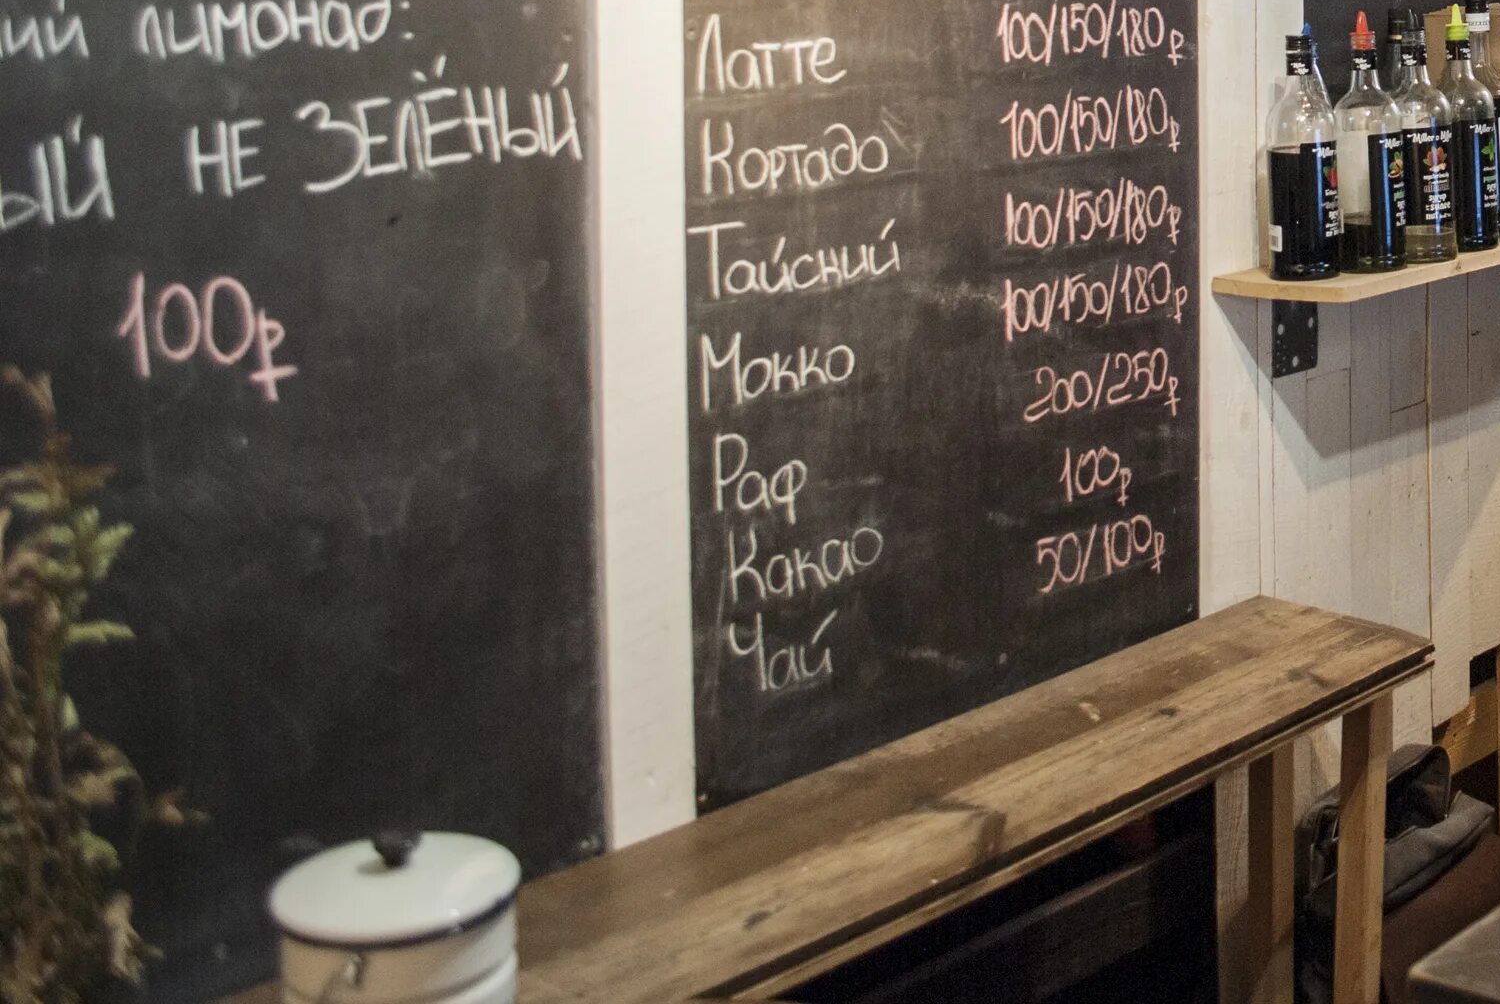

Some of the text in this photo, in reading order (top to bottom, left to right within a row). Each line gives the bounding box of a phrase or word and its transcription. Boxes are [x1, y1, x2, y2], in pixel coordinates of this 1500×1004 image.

[698, 13, 848, 94] Латте
[186, 118, 267, 198] НЕ
[295, 54, 585, 193] ЗЕЛЁНЫЙ
[700, 118, 890, 197] Кортадо
[701, 331, 856, 413] Мокко
[714, 432, 807, 525] Раф
[729, 526, 883, 602] Какао
[727, 609, 838, 692] Чай
